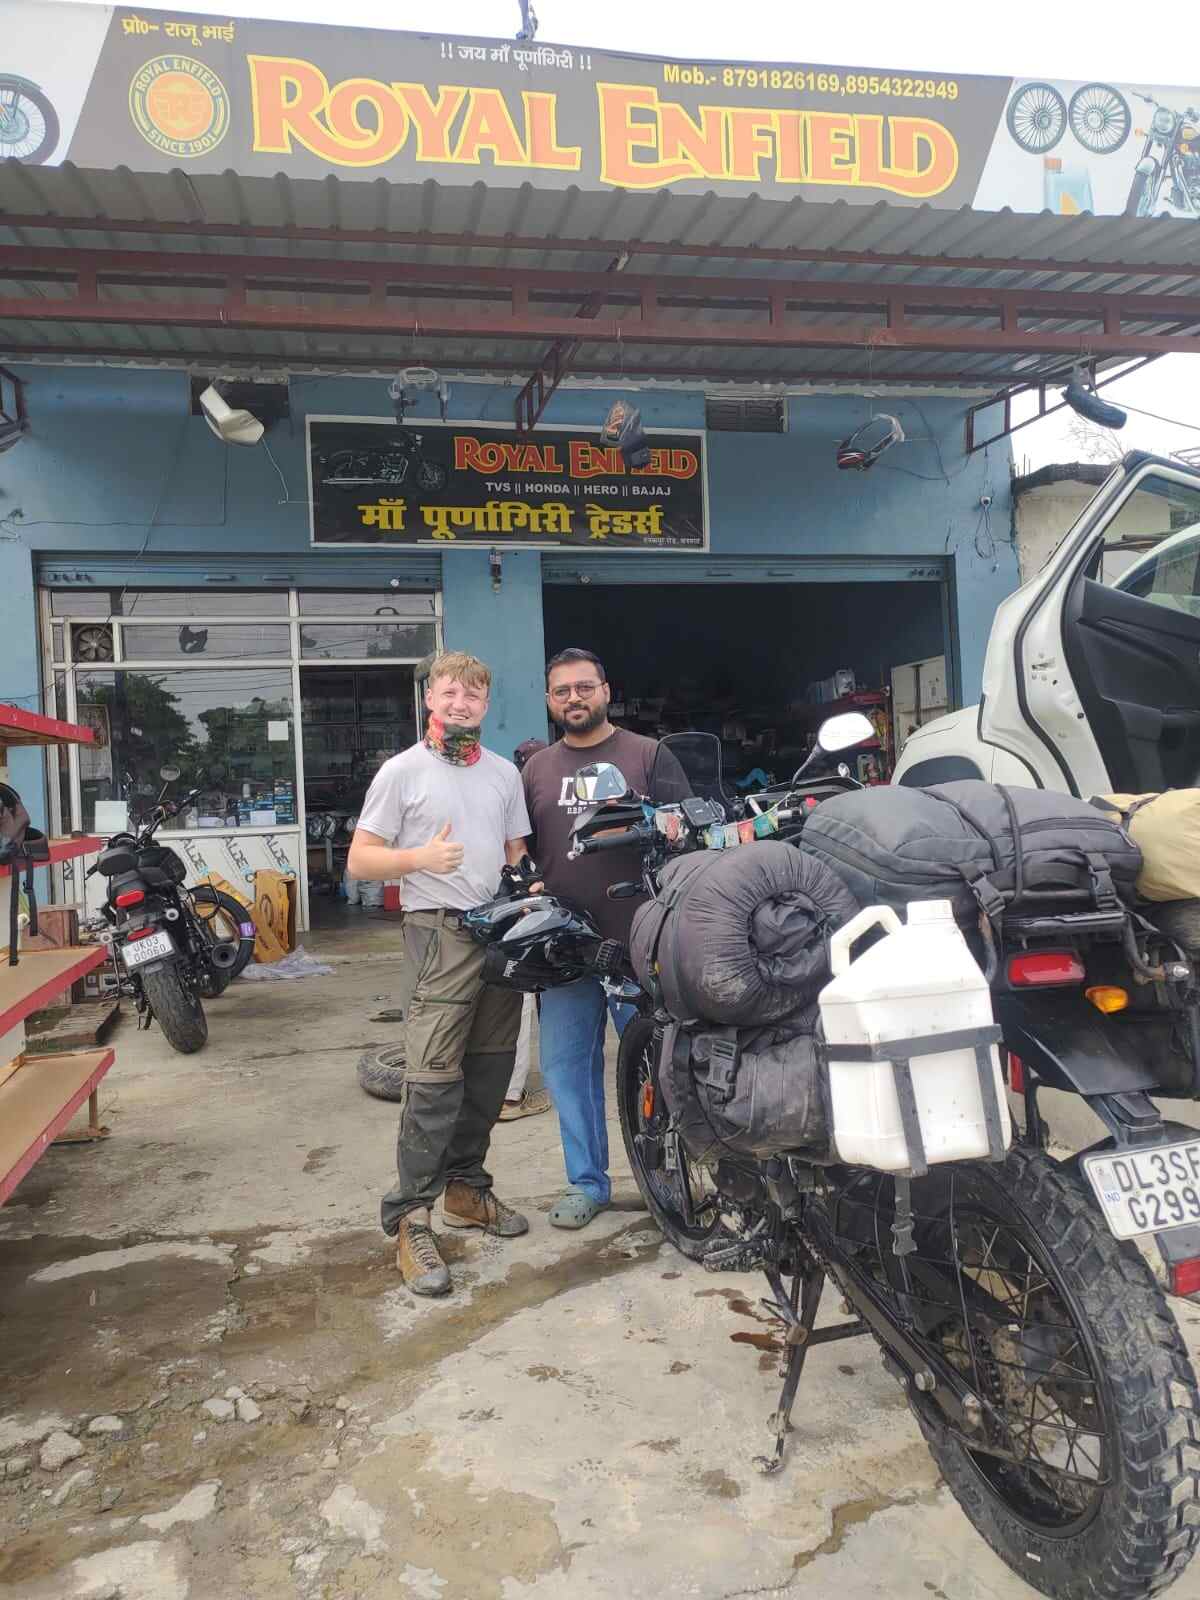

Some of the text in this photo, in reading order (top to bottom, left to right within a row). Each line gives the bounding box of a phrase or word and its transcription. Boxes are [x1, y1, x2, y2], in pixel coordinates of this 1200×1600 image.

[164, 22, 202, 48] राजू
[202, 21, 236, 43] भाई
[457, 45, 487, 61] जय
[135, 58, 222, 97] ROYAL ENFIELD
[147, 128, 187, 154] SINCE
[248, 54, 959, 198] ROYAL ENFIELD
[453, 436, 564, 474] ROYAL
[485, 481, 512, 493] TVS
[525, 482, 571, 495] HONDA
[583, 484, 619, 496] HERO
[632, 486, 672, 497] BAJAJ
[419, 500, 576, 540] पूर्णागिरी
[585, 503, 665, 539] ट्रेडर्स
